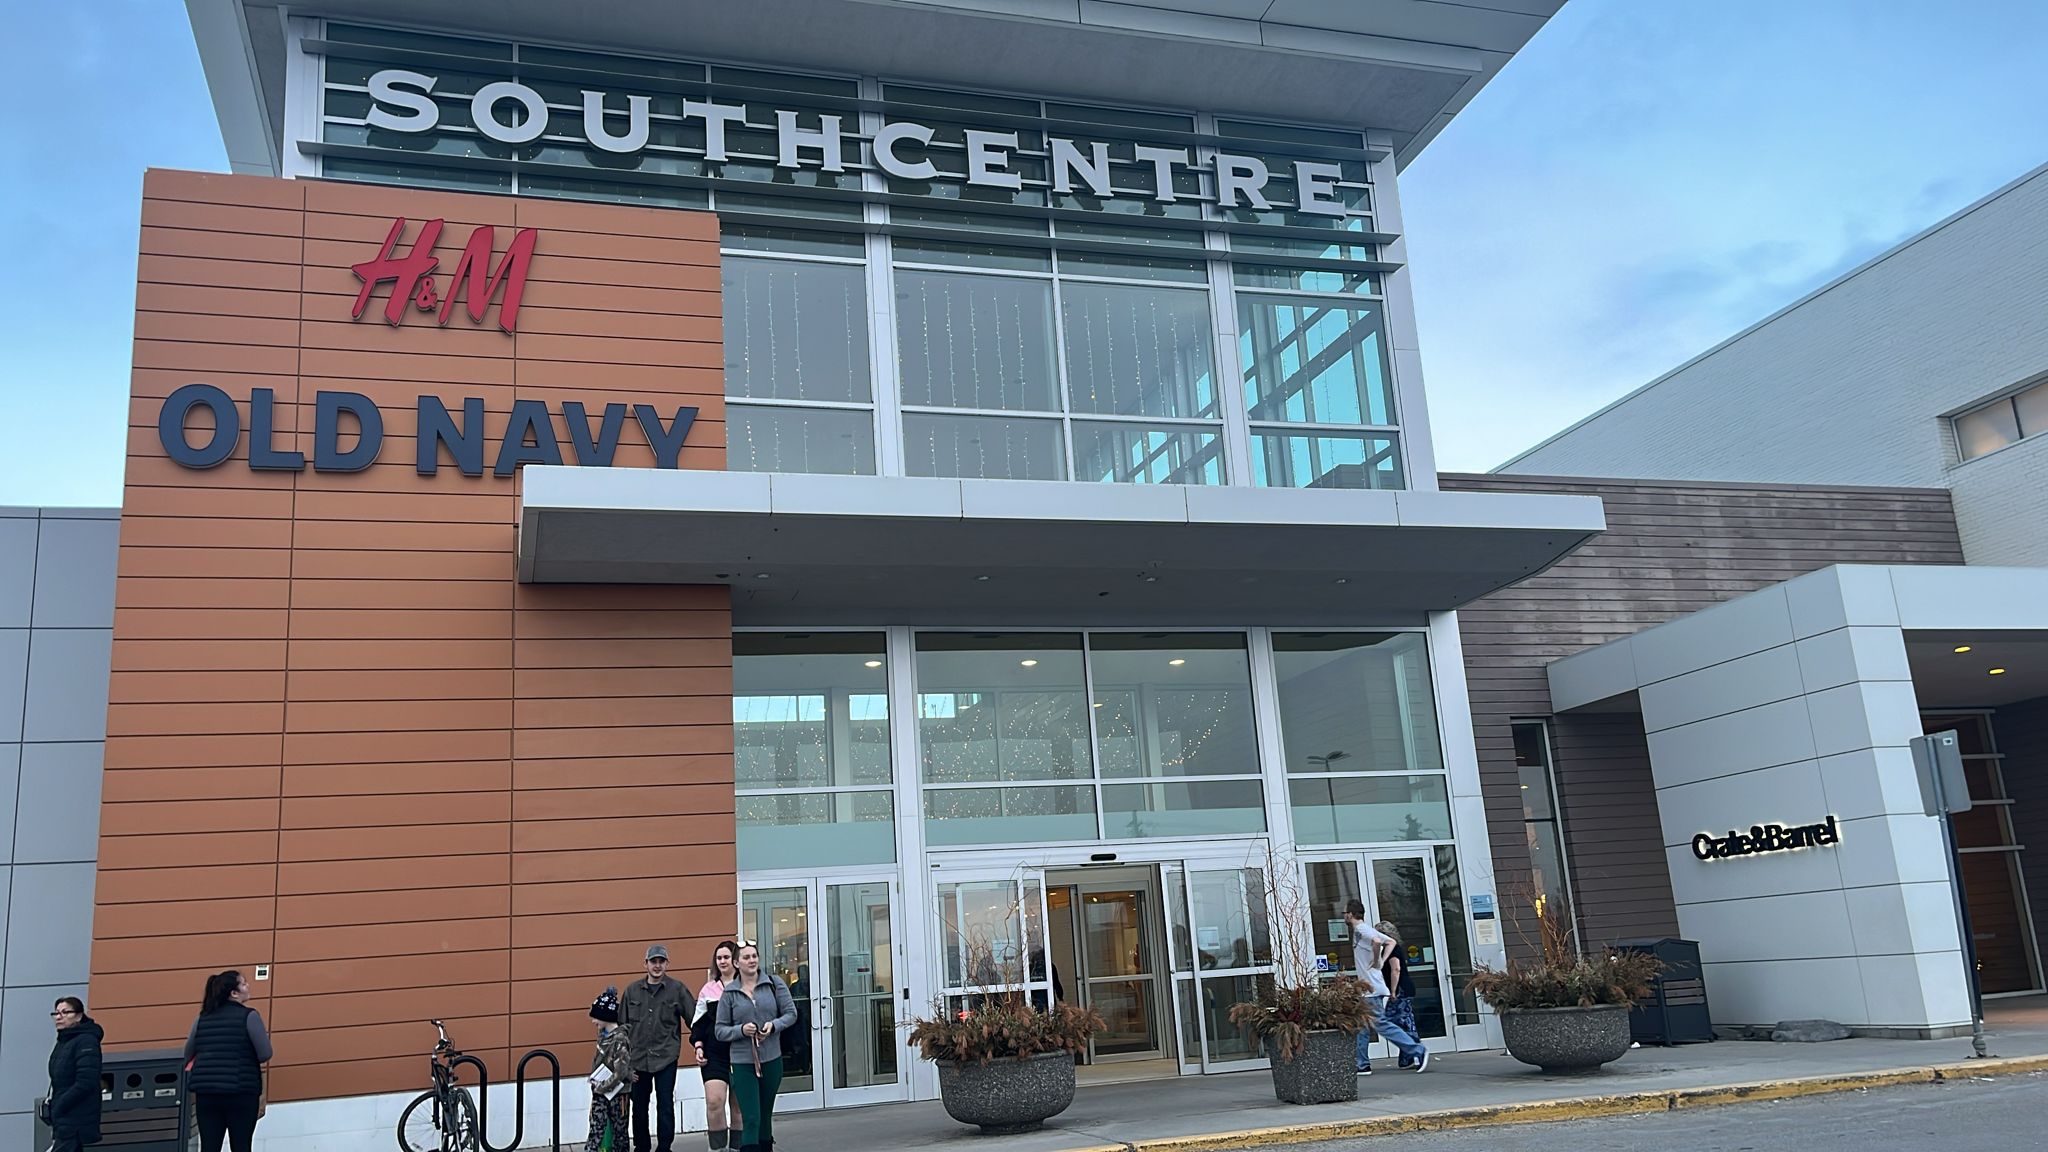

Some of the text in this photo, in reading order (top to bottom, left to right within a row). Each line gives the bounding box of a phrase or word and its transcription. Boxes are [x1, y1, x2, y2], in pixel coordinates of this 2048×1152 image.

[365, 69, 1346, 220] SOUTHCENTRE
[351, 216, 538, 335] H&M
[158, 383, 699, 477] OLD NAVY
[1692, 815, 1839, 860] Crate&Barrel
